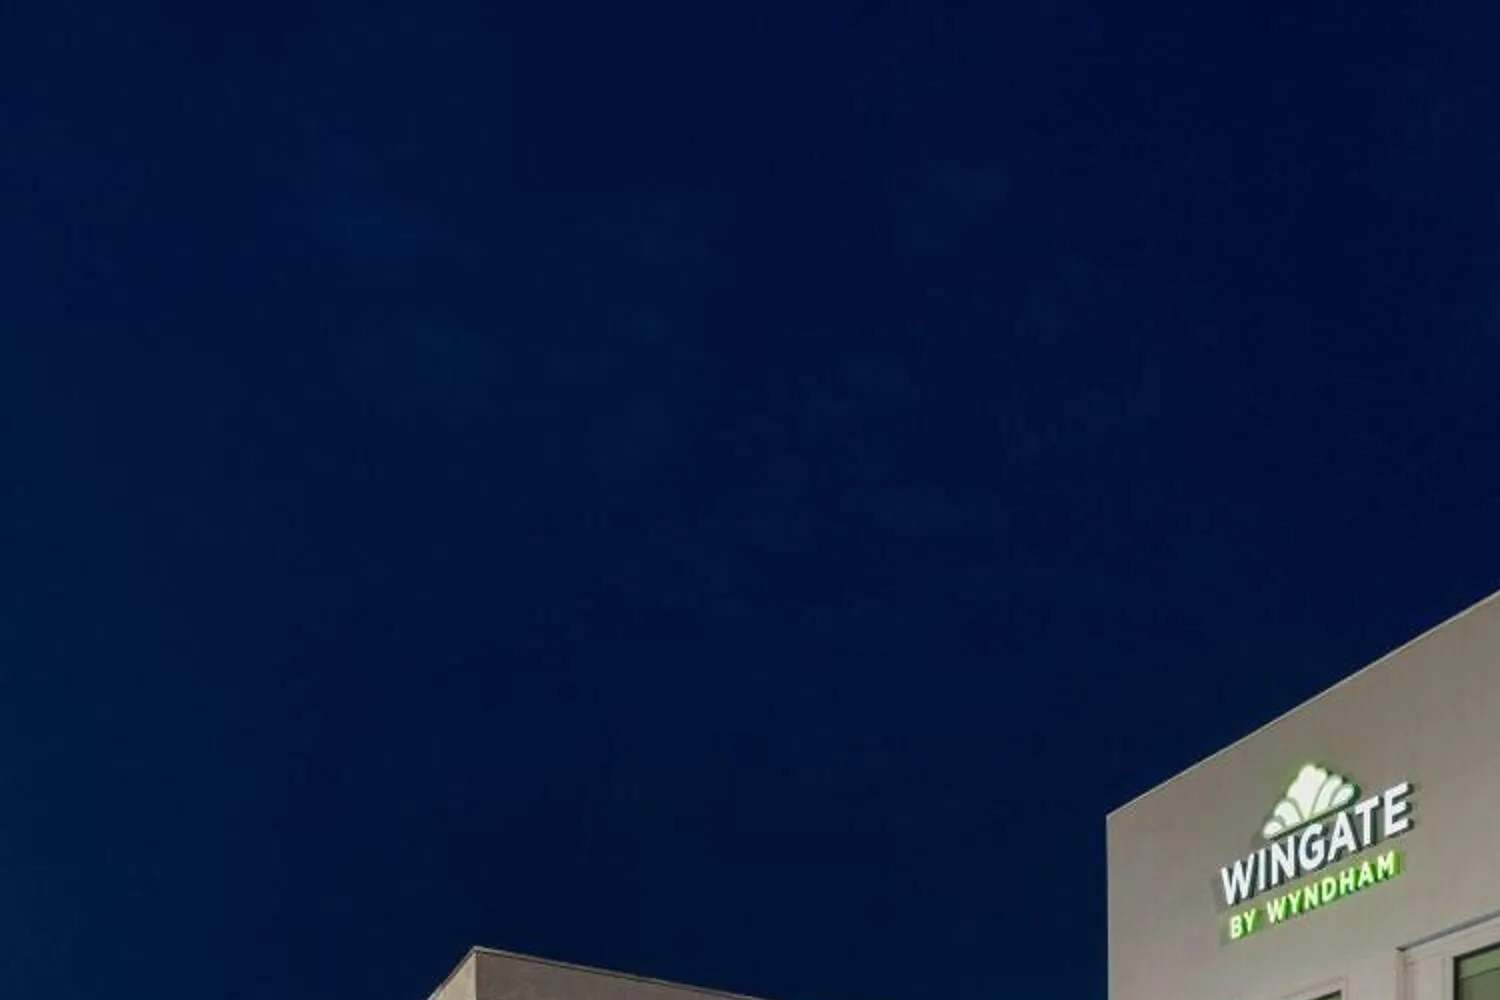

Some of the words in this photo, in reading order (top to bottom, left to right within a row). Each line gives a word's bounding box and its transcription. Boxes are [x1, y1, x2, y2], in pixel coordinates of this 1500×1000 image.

[1220, 781, 1411, 906] WINGATE
[1229, 908, 1257, 940] BY
[1266, 850, 1396, 924] WYNDHAM
